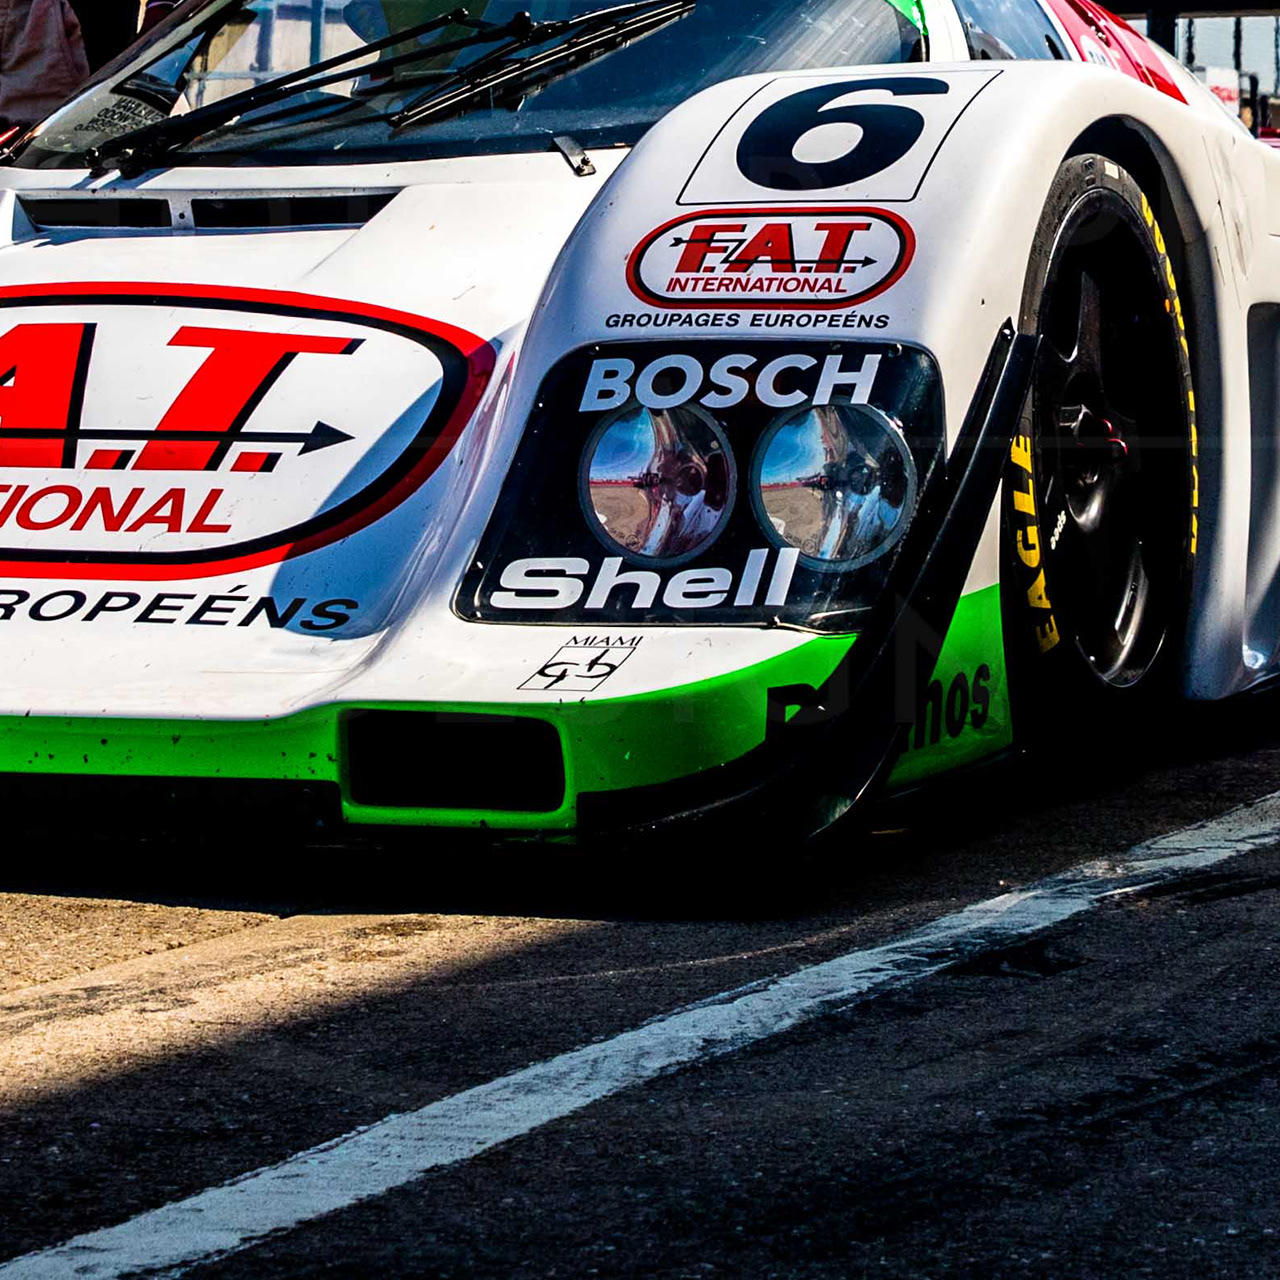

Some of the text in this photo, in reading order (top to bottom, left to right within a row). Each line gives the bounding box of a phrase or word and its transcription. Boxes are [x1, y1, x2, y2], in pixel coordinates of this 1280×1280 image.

[735, 76, 950, 192] 6
[675, 222, 874, 274] F.A.T.
[665, 276, 848, 295] INTERNATIONAL
[604, 309, 890, 331] GROUPAGES EUROPEÉNS
[578, 352, 883, 414] BOSCH
[1009, 432, 1061, 654] EAGLE
[488, 546, 801, 611] Shell
[565, 635, 644, 647] MIAMI
